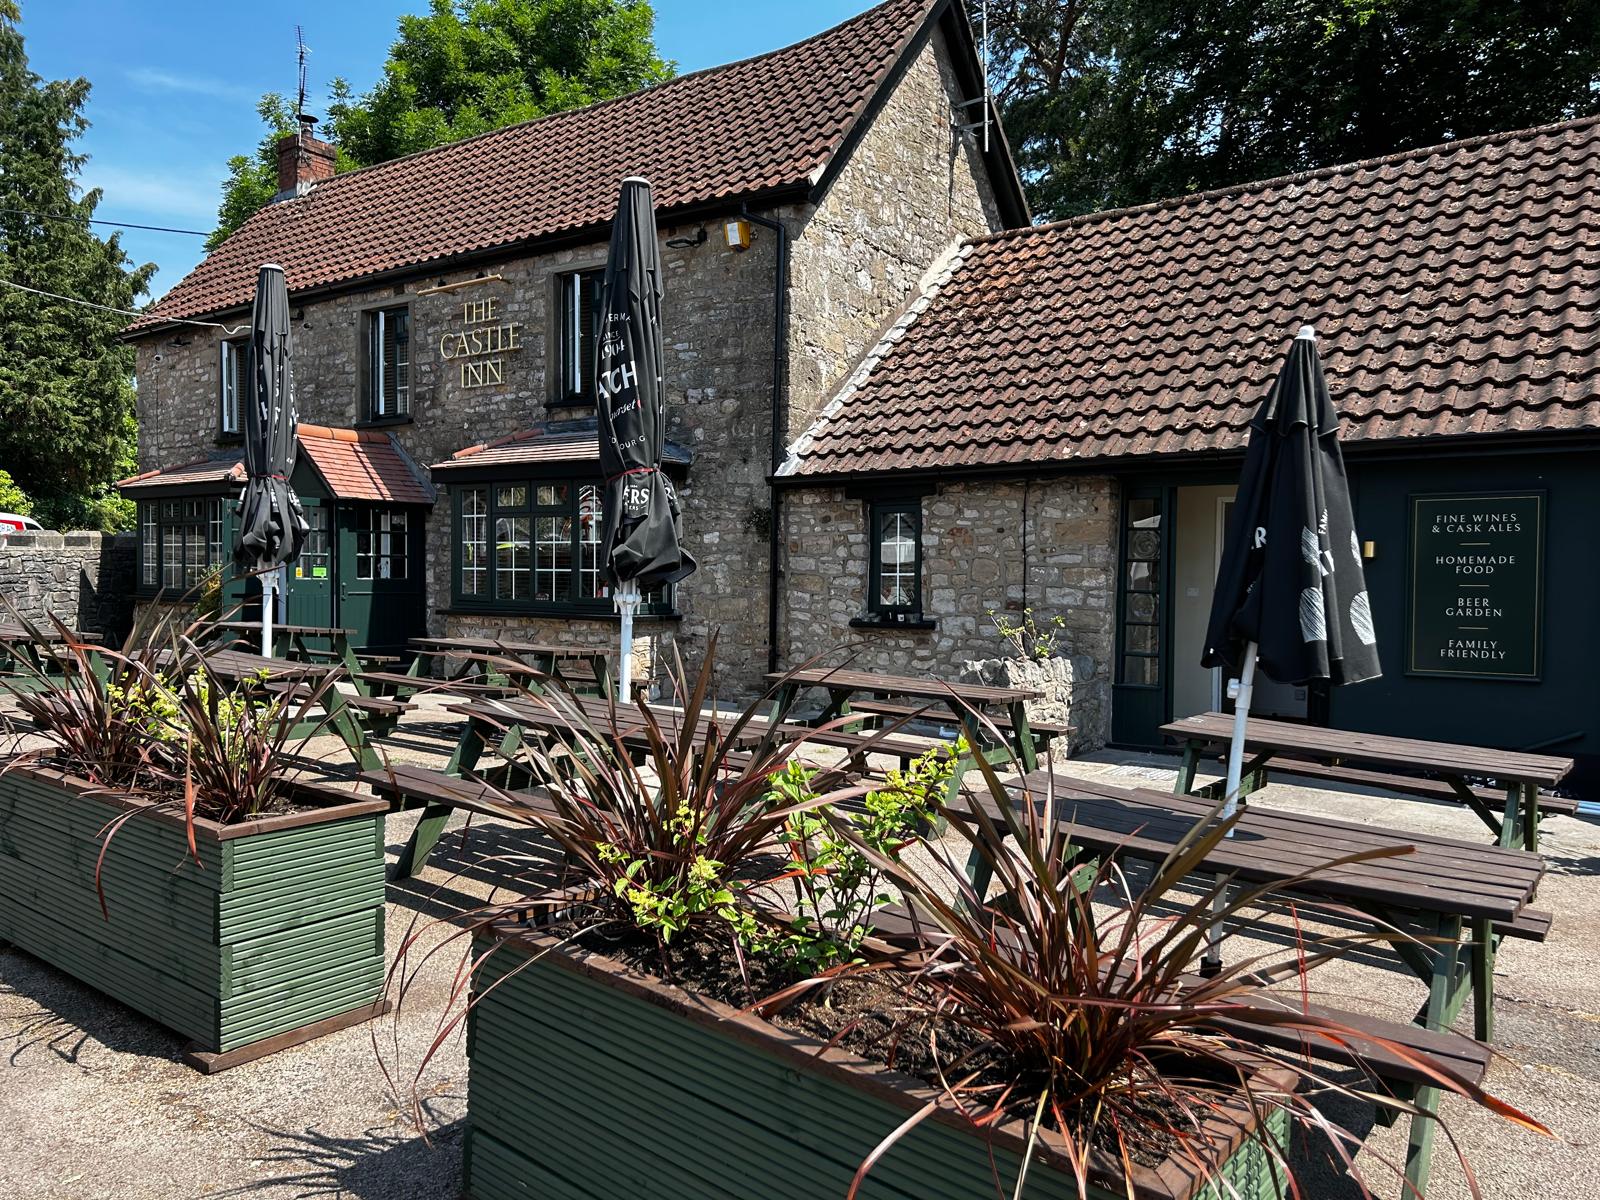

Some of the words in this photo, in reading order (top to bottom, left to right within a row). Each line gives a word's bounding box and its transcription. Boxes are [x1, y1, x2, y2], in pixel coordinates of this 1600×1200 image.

[461, 296, 497, 325] THE
[440, 322, 520, 359] CASTLE
[461, 359, 502, 388] INN
[1436, 515, 1466, 524] FINE
[1472, 513, 1517, 522] WINES
[1431, 525, 1440, 533] &
[1446, 524, 1482, 533] CASK
[1488, 523, 1521, 532] ALES
[1435, 555, 1516, 565] HOMEMADE
[1455, 565, 1494, 574] FOOD
[1457, 597, 1489, 607] BEER
[1445, 608, 1502, 617] GARDEN
[1448, 639, 1498, 649] FAMILY
[1440, 649, 1506, 659] FRIENDLY
